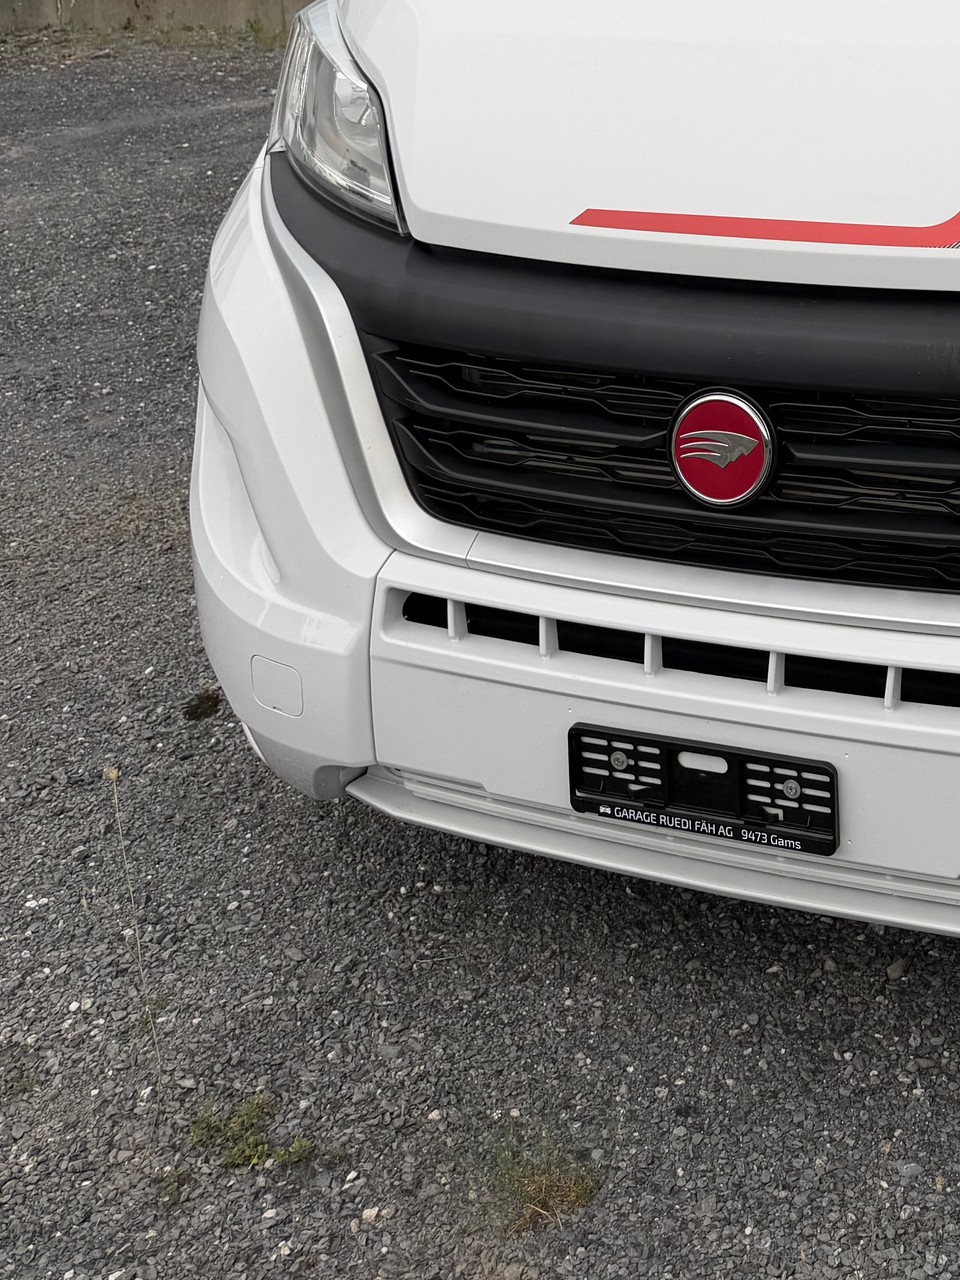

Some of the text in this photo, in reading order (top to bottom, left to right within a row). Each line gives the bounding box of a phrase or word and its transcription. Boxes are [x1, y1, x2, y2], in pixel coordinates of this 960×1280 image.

[614, 807, 801, 850] GARAGE RUEDI FÄH AG 9473 Gams
